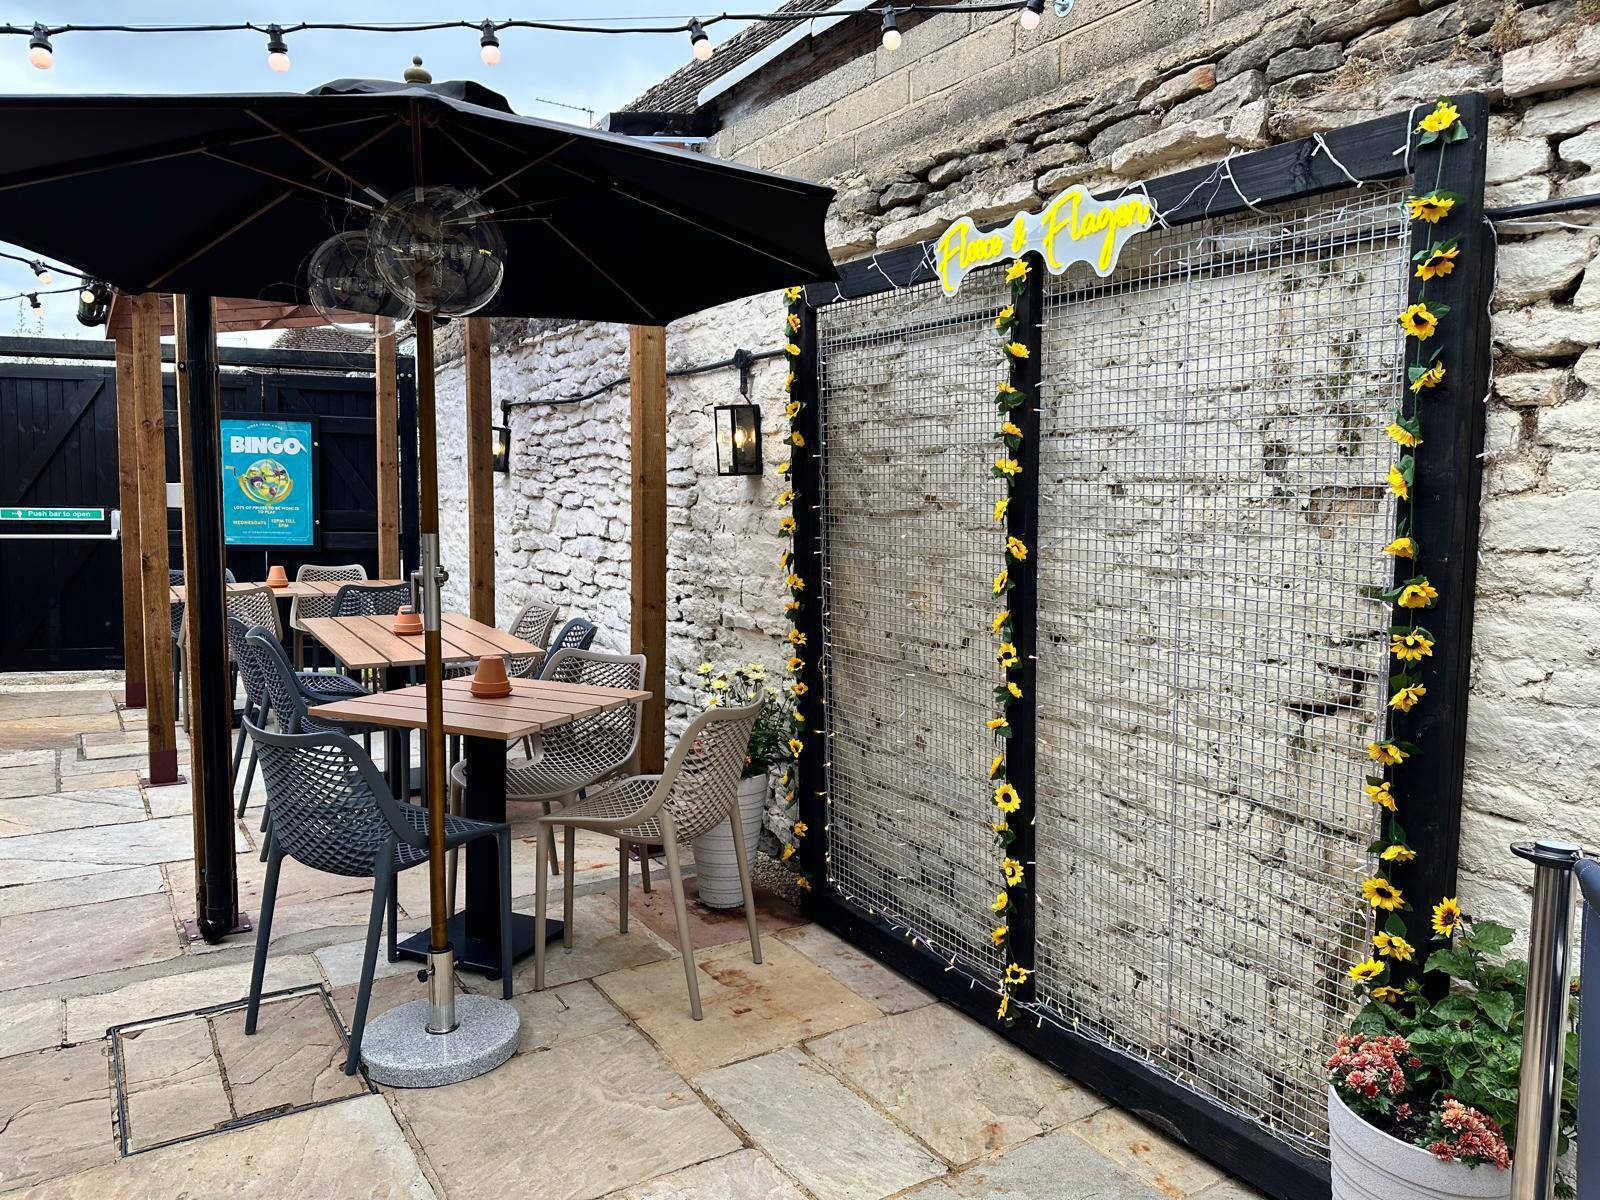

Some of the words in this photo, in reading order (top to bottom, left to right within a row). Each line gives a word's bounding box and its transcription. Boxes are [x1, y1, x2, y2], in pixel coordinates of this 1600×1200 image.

[1011, 217, 1027, 252] &
[1041, 191, 1152, 271] Flagon
[230, 436, 307, 455] BINGO
